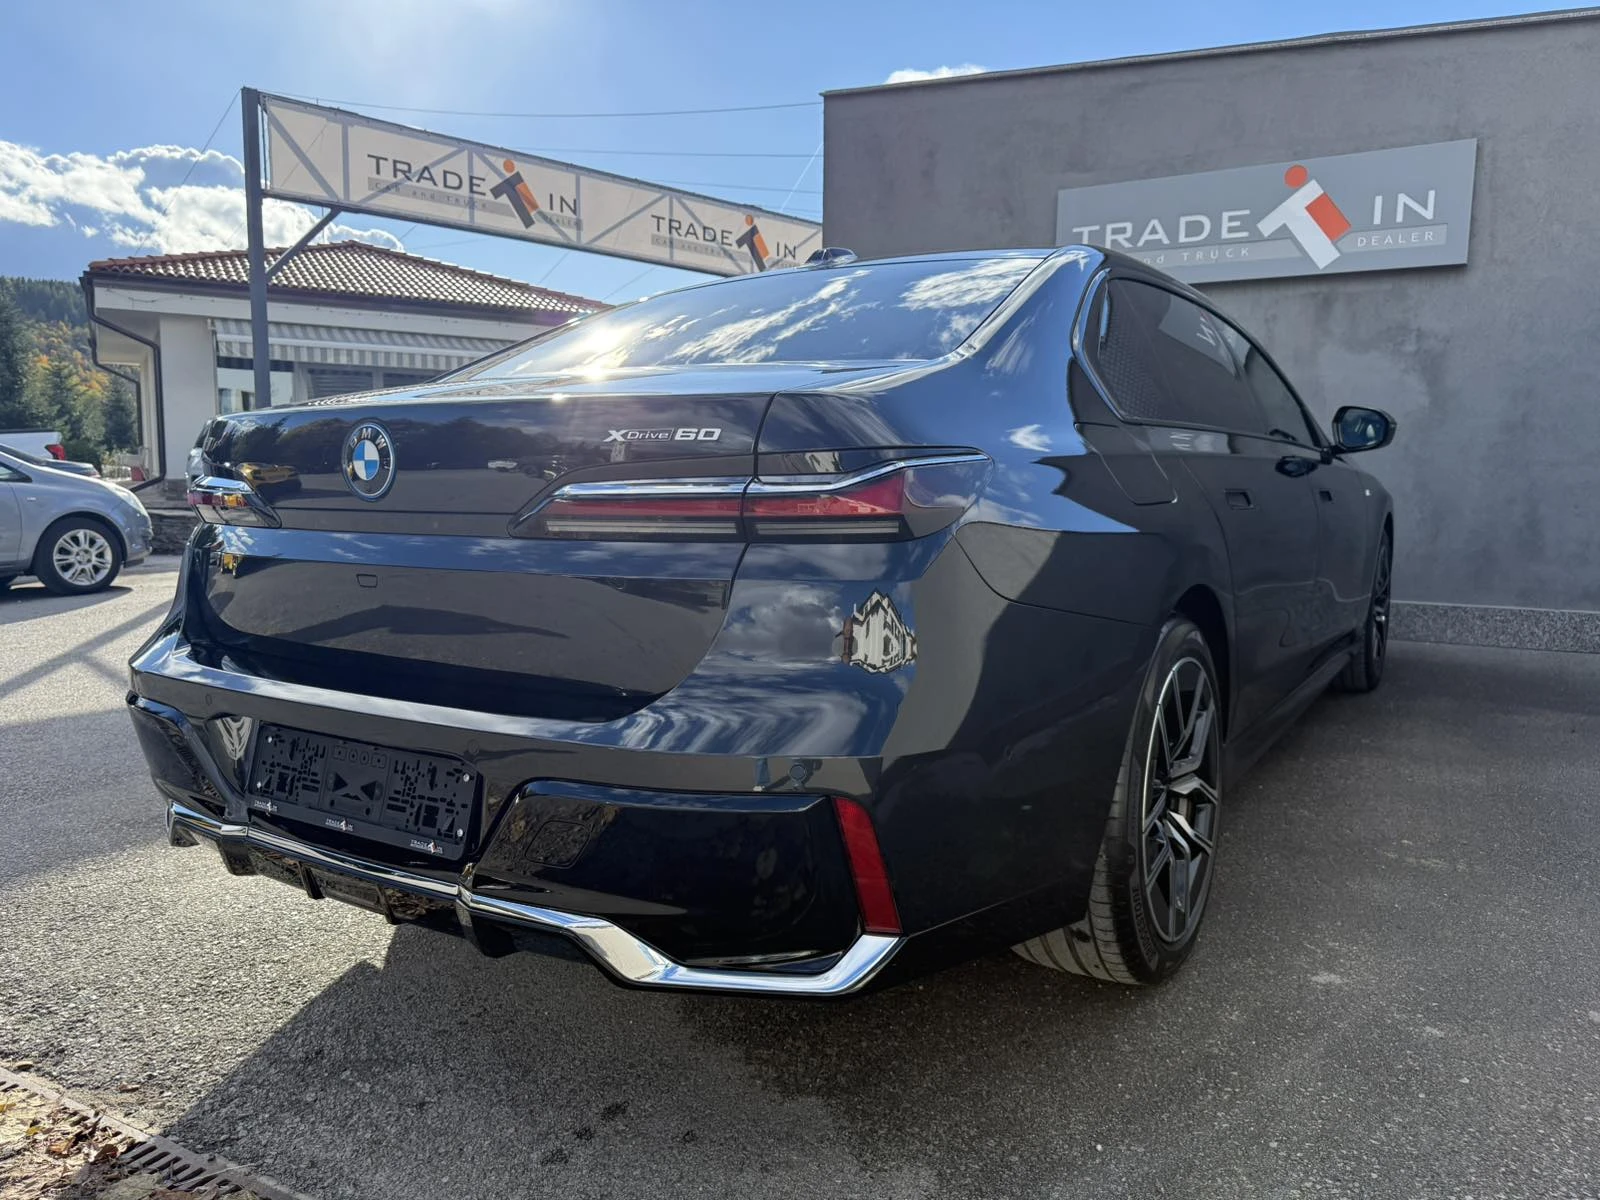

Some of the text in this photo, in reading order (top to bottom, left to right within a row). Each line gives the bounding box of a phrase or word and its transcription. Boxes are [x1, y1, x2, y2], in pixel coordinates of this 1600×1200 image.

[367, 154, 487, 196] TRADE
[549, 193, 578, 216] IN
[1072, 209, 1251, 249] TRADE
[1373, 189, 1436, 225] IN
[651, 215, 733, 247] TRADE
[776, 241, 797, 260] IN
[1357, 230, 1434, 248] DEALER
[1181, 247, 1250, 262] TRUCK
[349, 427, 387, 450] BMW
[674, 428, 722, 441] 60
